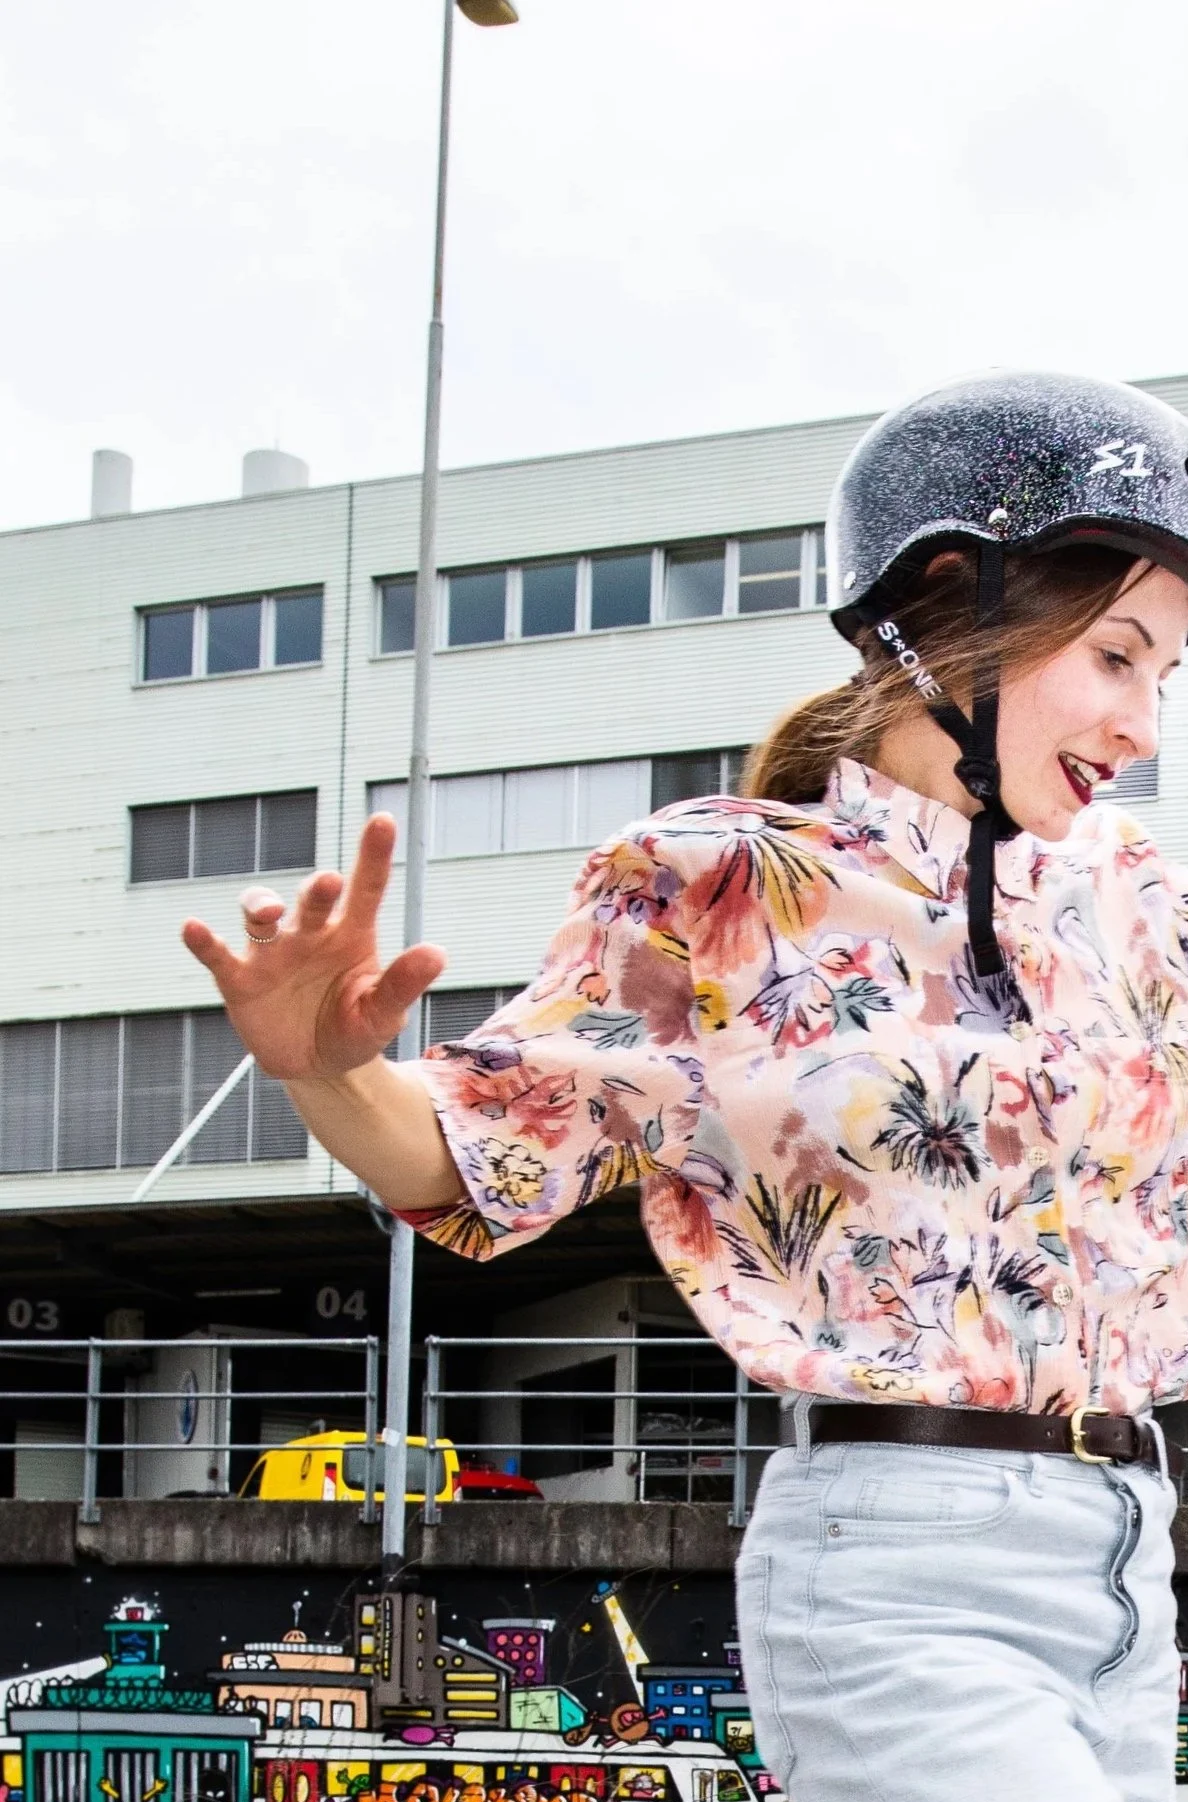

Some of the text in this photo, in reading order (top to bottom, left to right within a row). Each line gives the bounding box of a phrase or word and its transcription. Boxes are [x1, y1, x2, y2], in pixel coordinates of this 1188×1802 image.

[1085, 440, 1155, 478] S1
[7, 1299, 60, 1332] 03
[316, 1286, 367, 1321] 04
